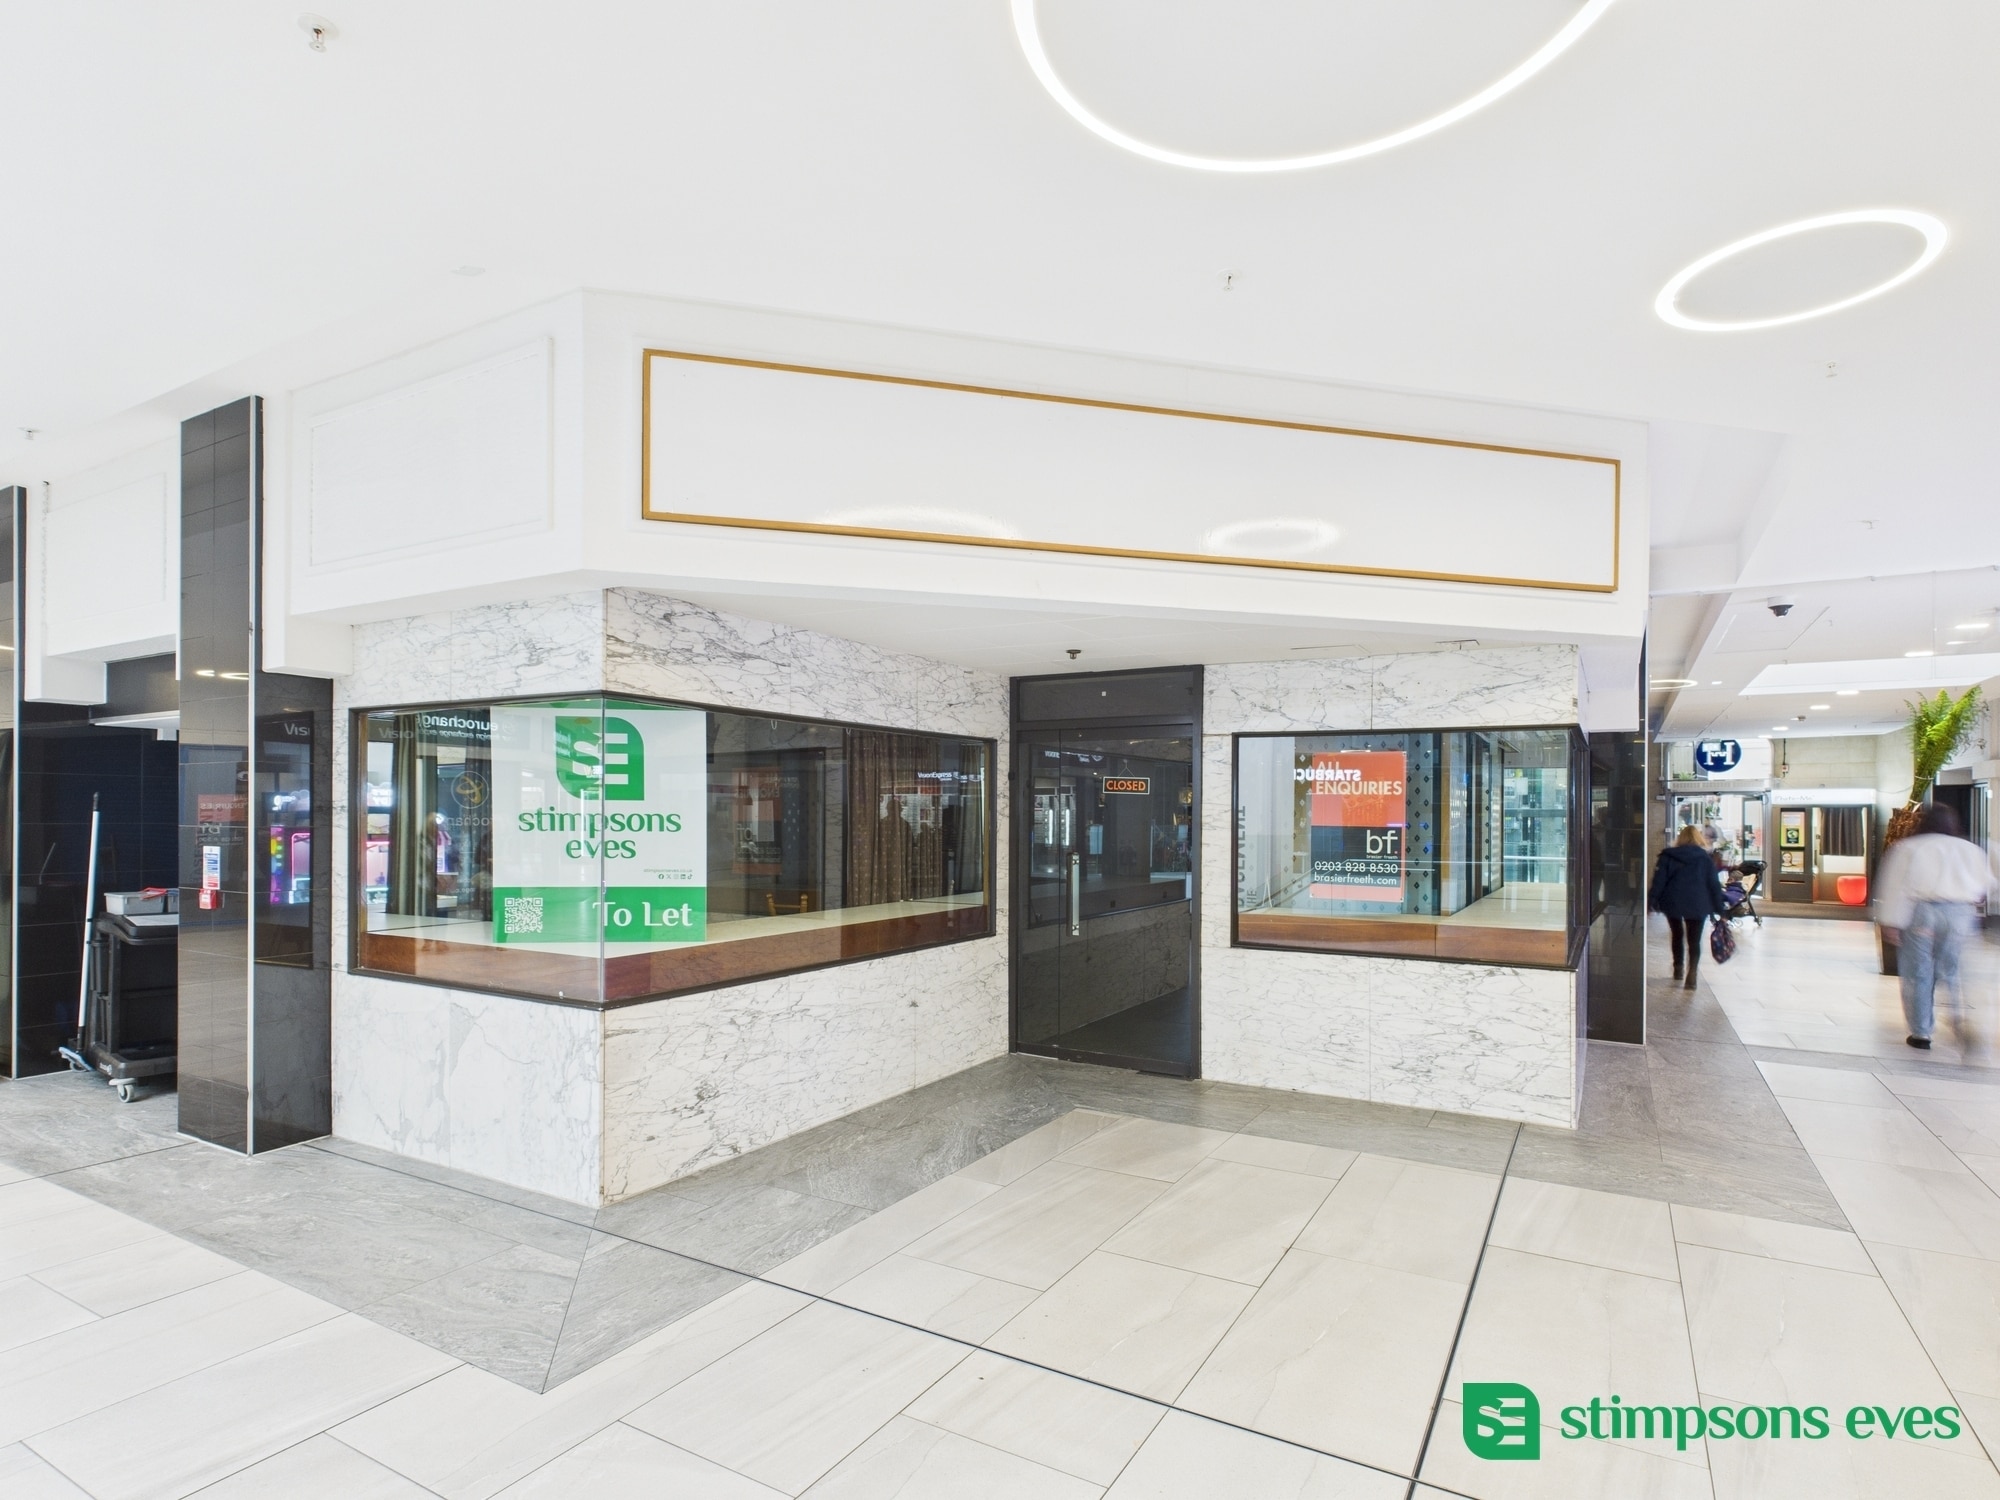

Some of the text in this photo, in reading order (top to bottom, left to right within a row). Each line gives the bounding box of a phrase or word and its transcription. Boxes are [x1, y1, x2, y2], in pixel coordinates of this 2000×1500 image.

[1106, 780, 1146, 791] CLOSED
[1315, 781, 1403, 795] ENQUIRIES
[518, 806, 682, 838] stimpsons
[565, 838, 637, 859] eves
[1314, 861, 1398, 874] 0203 828 8530
[1314, 871, 1397, 885] brasierfreeth.com
[592, 901, 693, 927] To Let
